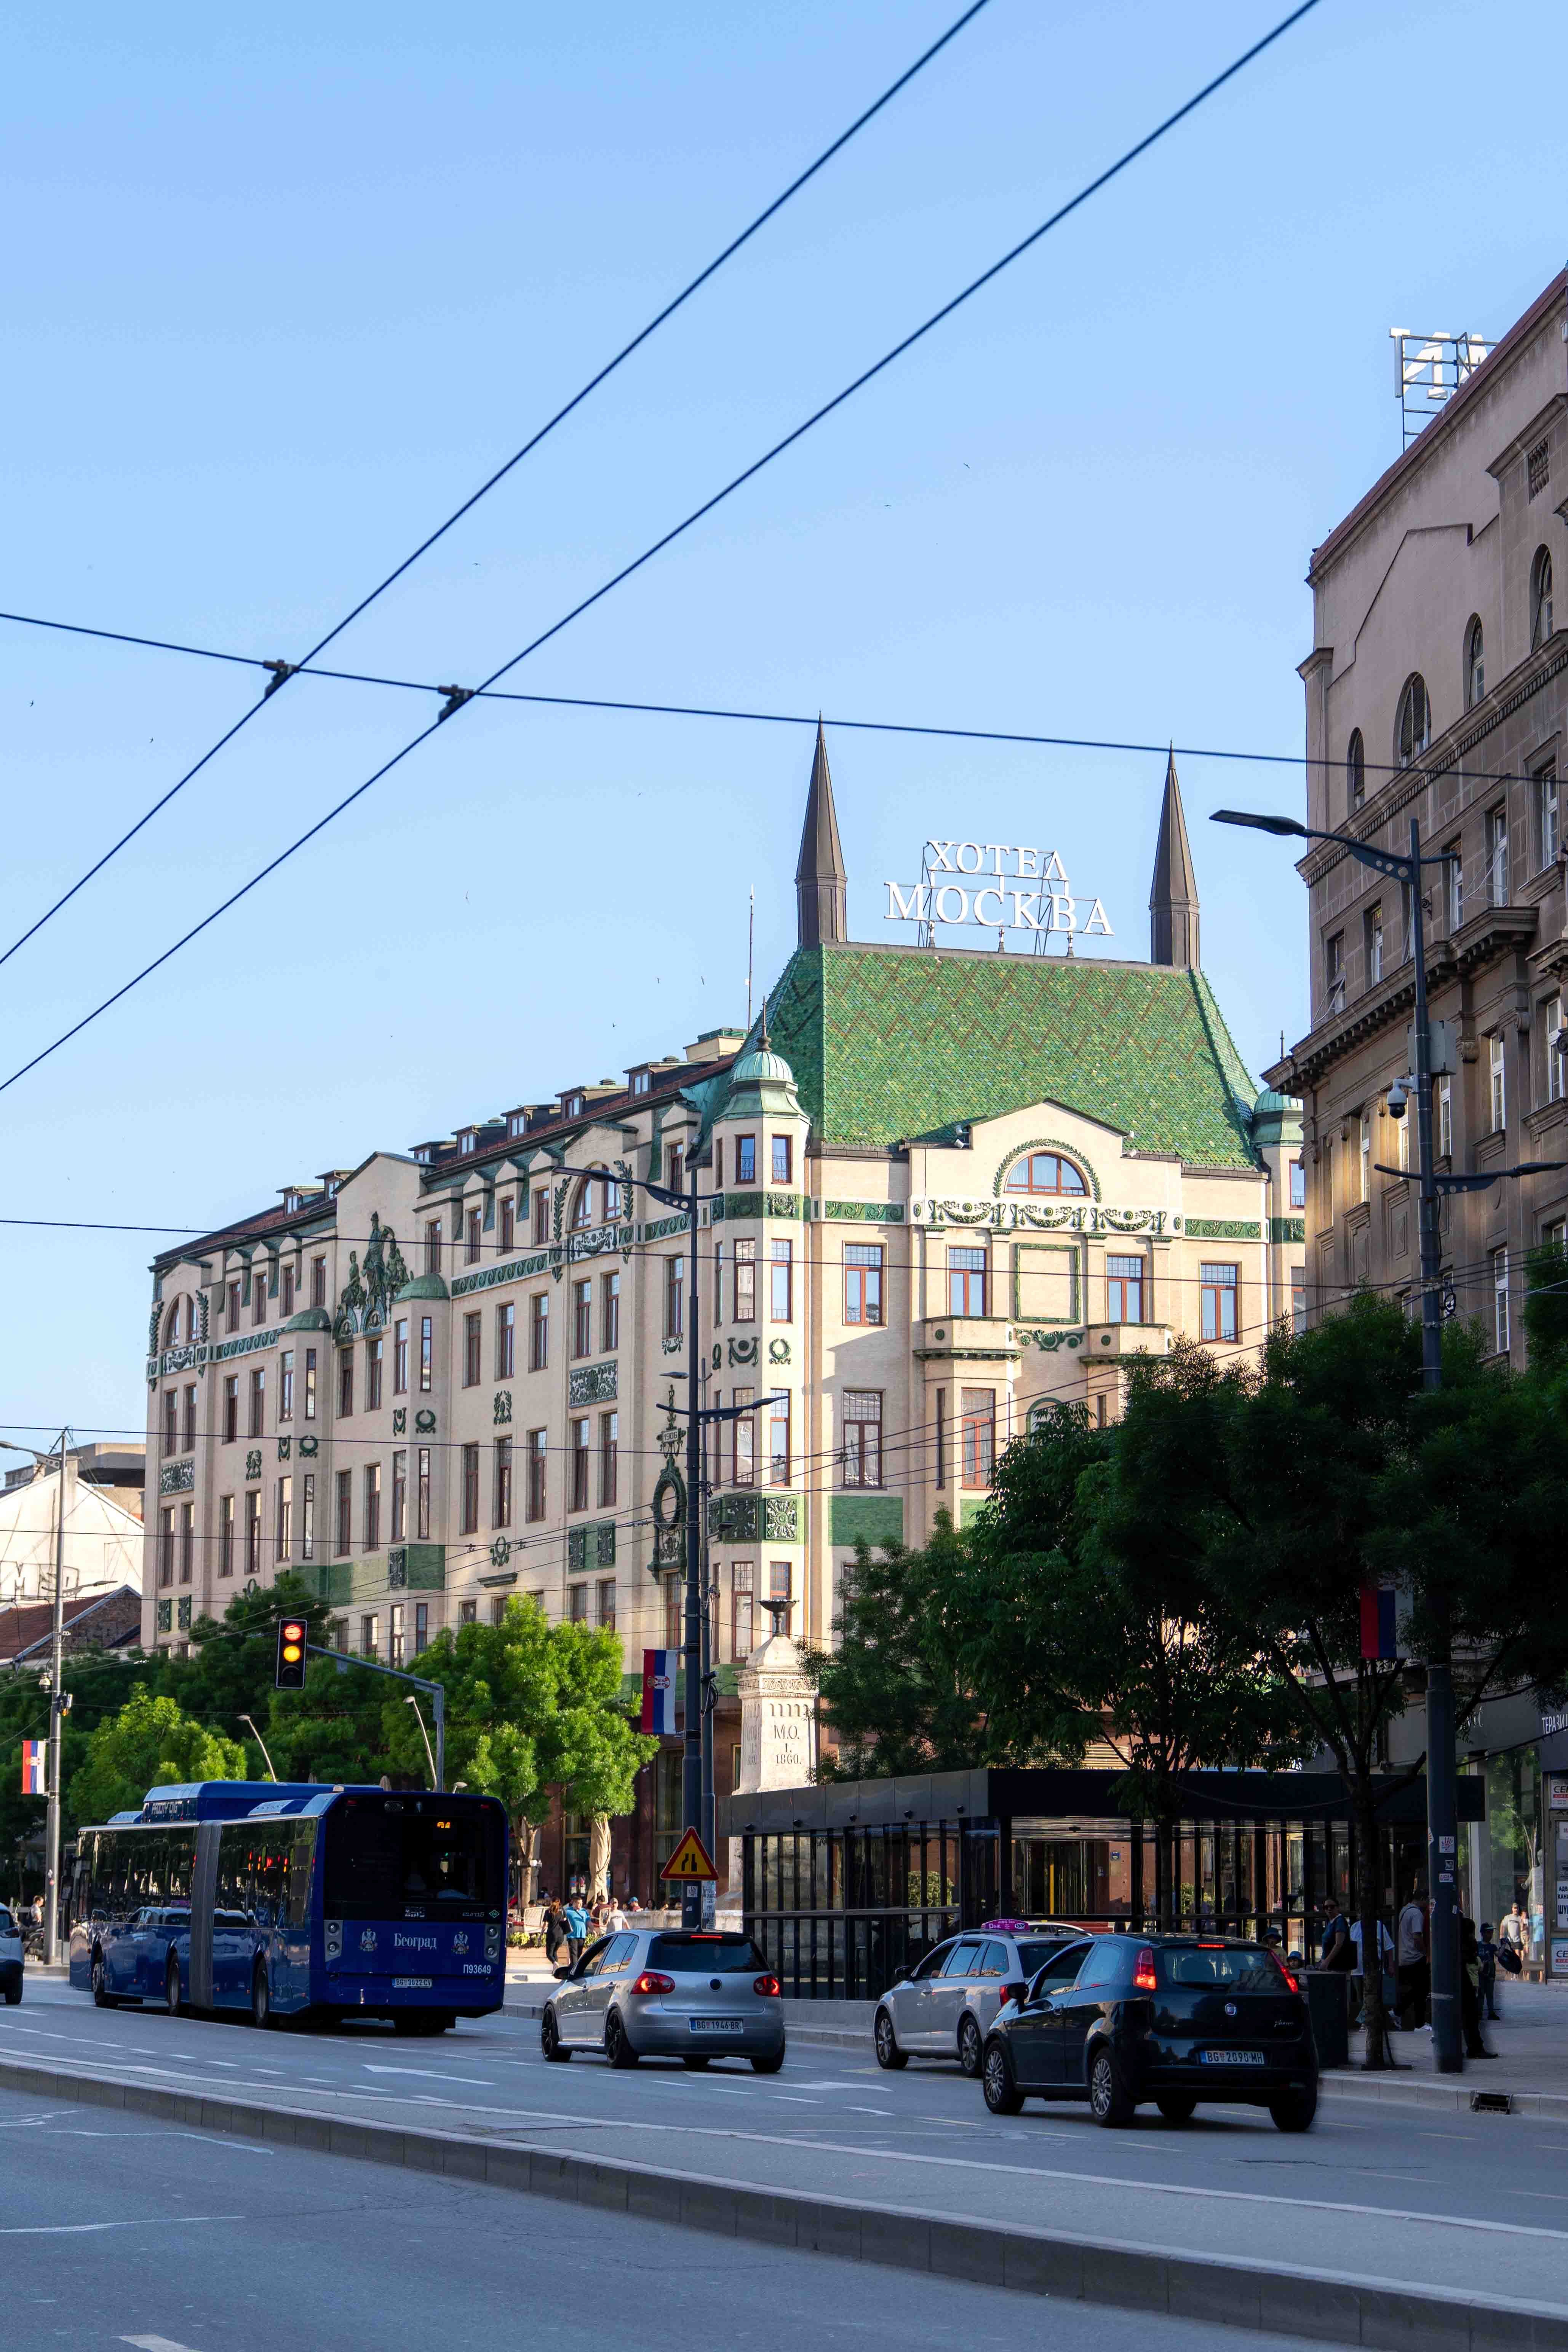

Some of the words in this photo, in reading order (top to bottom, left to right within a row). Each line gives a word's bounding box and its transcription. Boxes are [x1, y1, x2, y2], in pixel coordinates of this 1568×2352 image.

[927, 840, 1069, 881] ХОТЕЛ
[884, 882, 1114, 936] МОСКВА
[394, 1933, 437, 1951] Београд
[463, 1964, 491, 1974] П93649
[1207, 2052, 1219, 2062] BG
